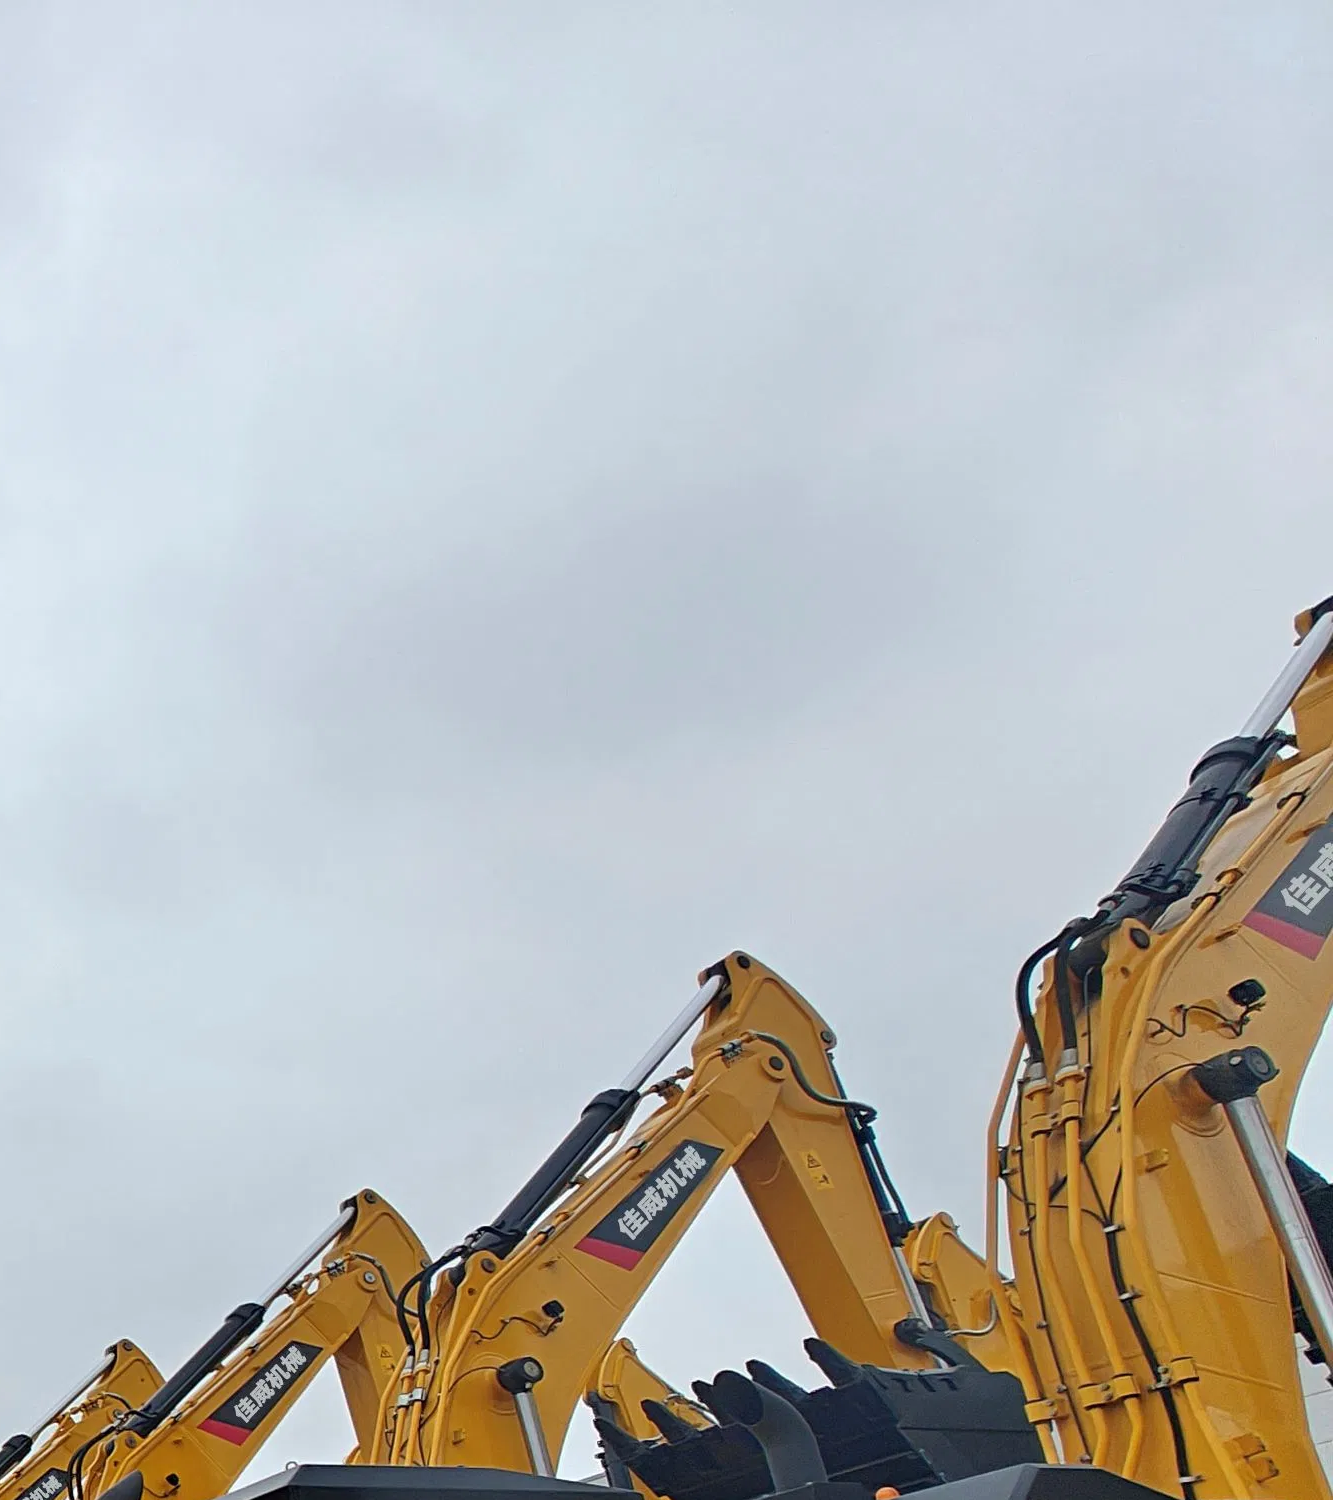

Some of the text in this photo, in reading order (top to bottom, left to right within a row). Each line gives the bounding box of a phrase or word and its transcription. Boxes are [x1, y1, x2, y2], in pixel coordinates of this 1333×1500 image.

[617, 1145, 707, 1240] 佳威机械
[233, 1345, 307, 1424] 佳威机械
